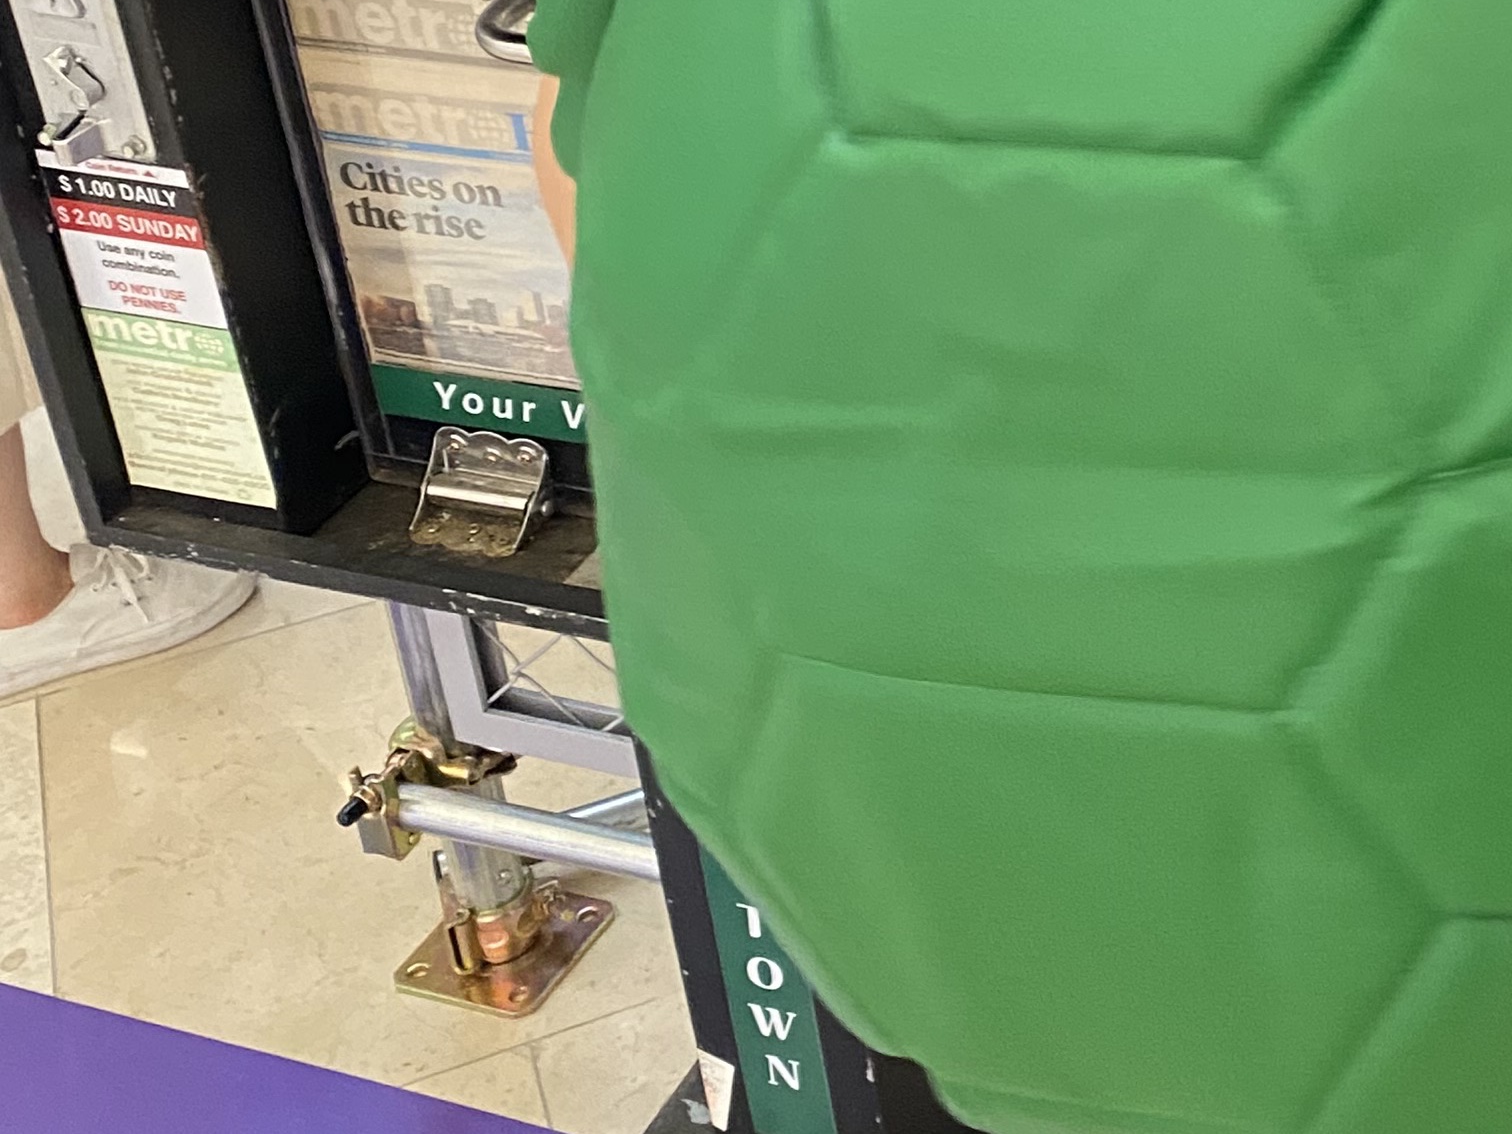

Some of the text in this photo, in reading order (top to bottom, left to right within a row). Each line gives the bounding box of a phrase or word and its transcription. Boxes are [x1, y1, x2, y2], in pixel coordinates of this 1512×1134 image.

[118, 182, 177, 209] DAILY
[339, 161, 505, 209] Cities on
[116, 214, 200, 243] SUNDAY
[345, 196, 487, 242] the rise
[97, 240, 176, 263] Use any coin
[102, 257, 181, 279] combination.
[108, 279, 188, 303] DO NOT USE
[432, 381, 537, 423] Your
